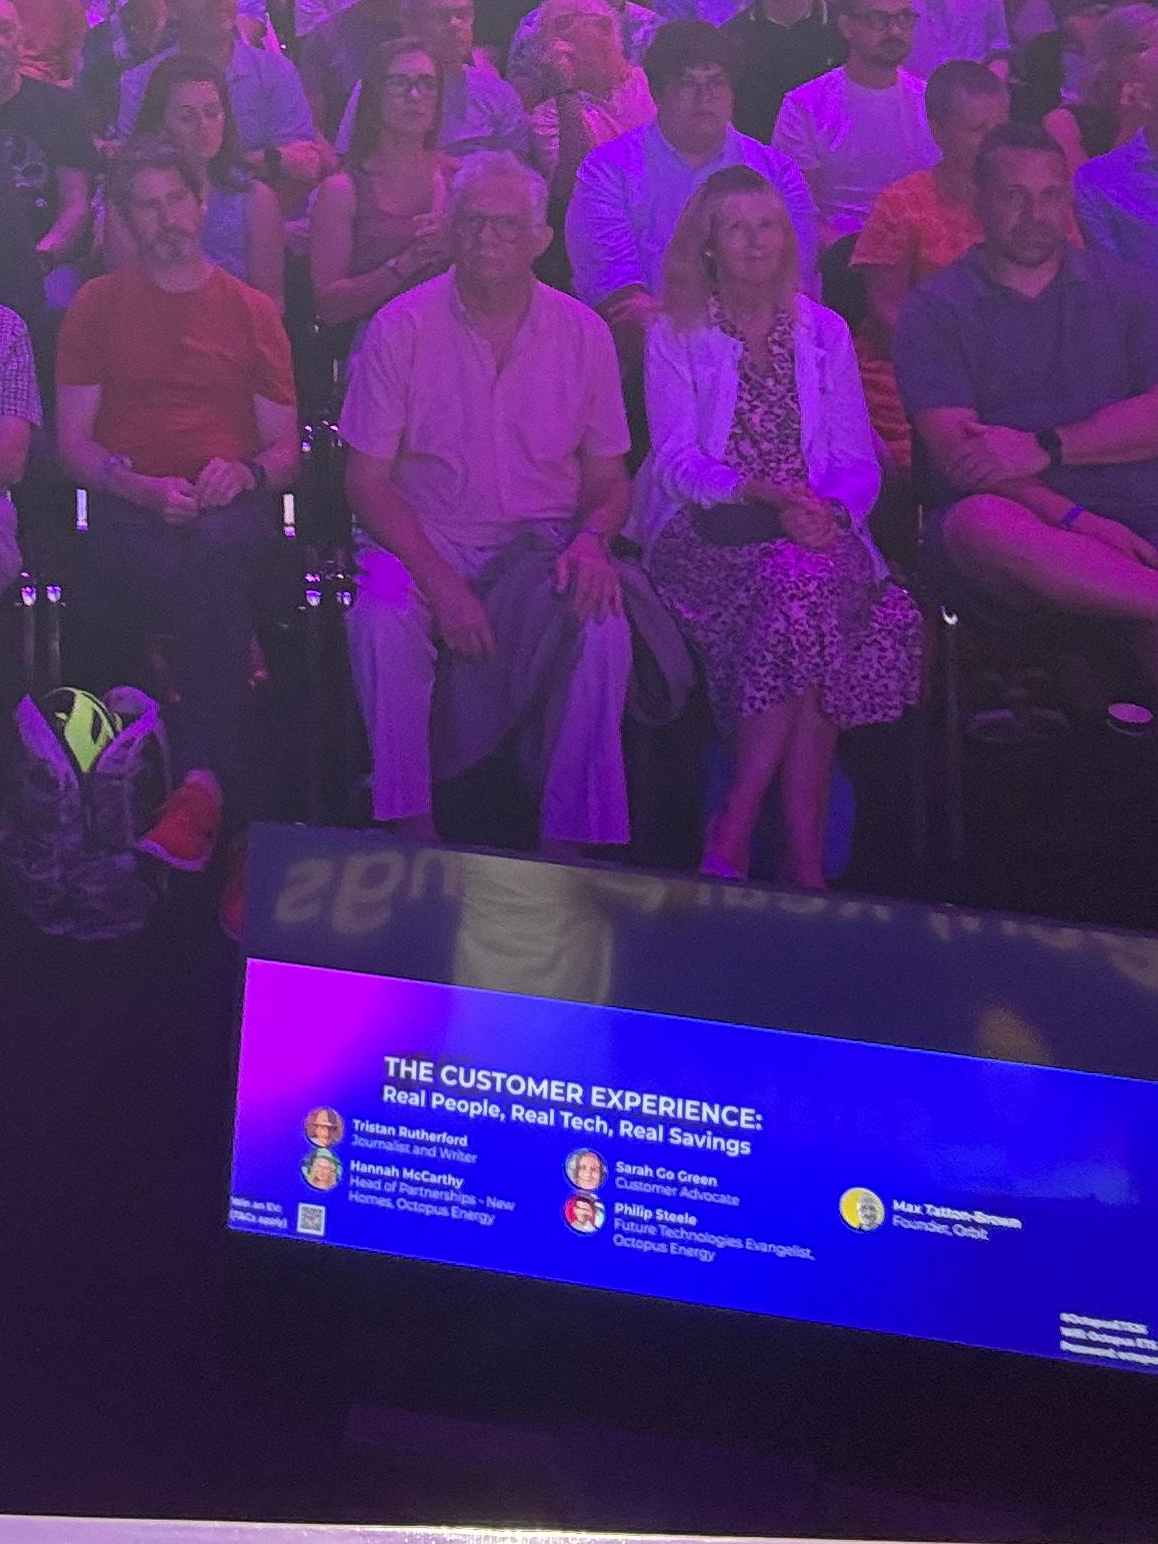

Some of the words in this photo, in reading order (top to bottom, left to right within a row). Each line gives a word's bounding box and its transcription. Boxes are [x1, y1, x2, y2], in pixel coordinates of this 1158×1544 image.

[384, 1055, 433, 1082] THE
[441, 1064, 583, 1104] CUSTOMER
[592, 1085, 763, 1130] EXPERIENCE:
[353, 1118, 395, 1136] Tristan
[400, 1125, 468, 1147] Rutherford
[383, 1085, 426, 1106] Real
[432, 1091, 506, 1121] People,
[511, 1104, 554, 1125] Real
[560, 1110, 613, 1137] Tech,
[620, 1119, 664, 1142] Real
[669, 1126, 751, 1156] Savings
[351, 1133, 410, 1154] Journalist
[413, 1143, 436, 1157] and
[442, 1148, 478, 1164] Writer
[350, 1159, 400, 1178] Hannah
[403, 1167, 465, 1190] McCarthy
[616, 1160, 653, 1177] Sarah
[656, 1166, 674, 1180] Go
[678, 1169, 718, 1187] Green
[349, 1175, 382, 1191] Head
[385, 1181, 397, 1193] of
[400, 1183, 477, 1206] Partnerships
[487, 1196, 516, 1212] New
[615, 1176, 677, 1197] Customer
[680, 1186, 740, 1207] Advocate
[395, 1198, 450, 1217] Octopus
[451, 1206, 495, 1225] Energy
[615, 1202, 653, 1220] Philip
[656, 1209, 697, 1227] Steele
[893, 1199, 923, 1215] Max
[614, 1218, 658, 1235] Future
[659, 1224, 743, 1248] Technologies
[614, 1234, 668, 1253] Octopus
[670, 1242, 716, 1262] Energy
